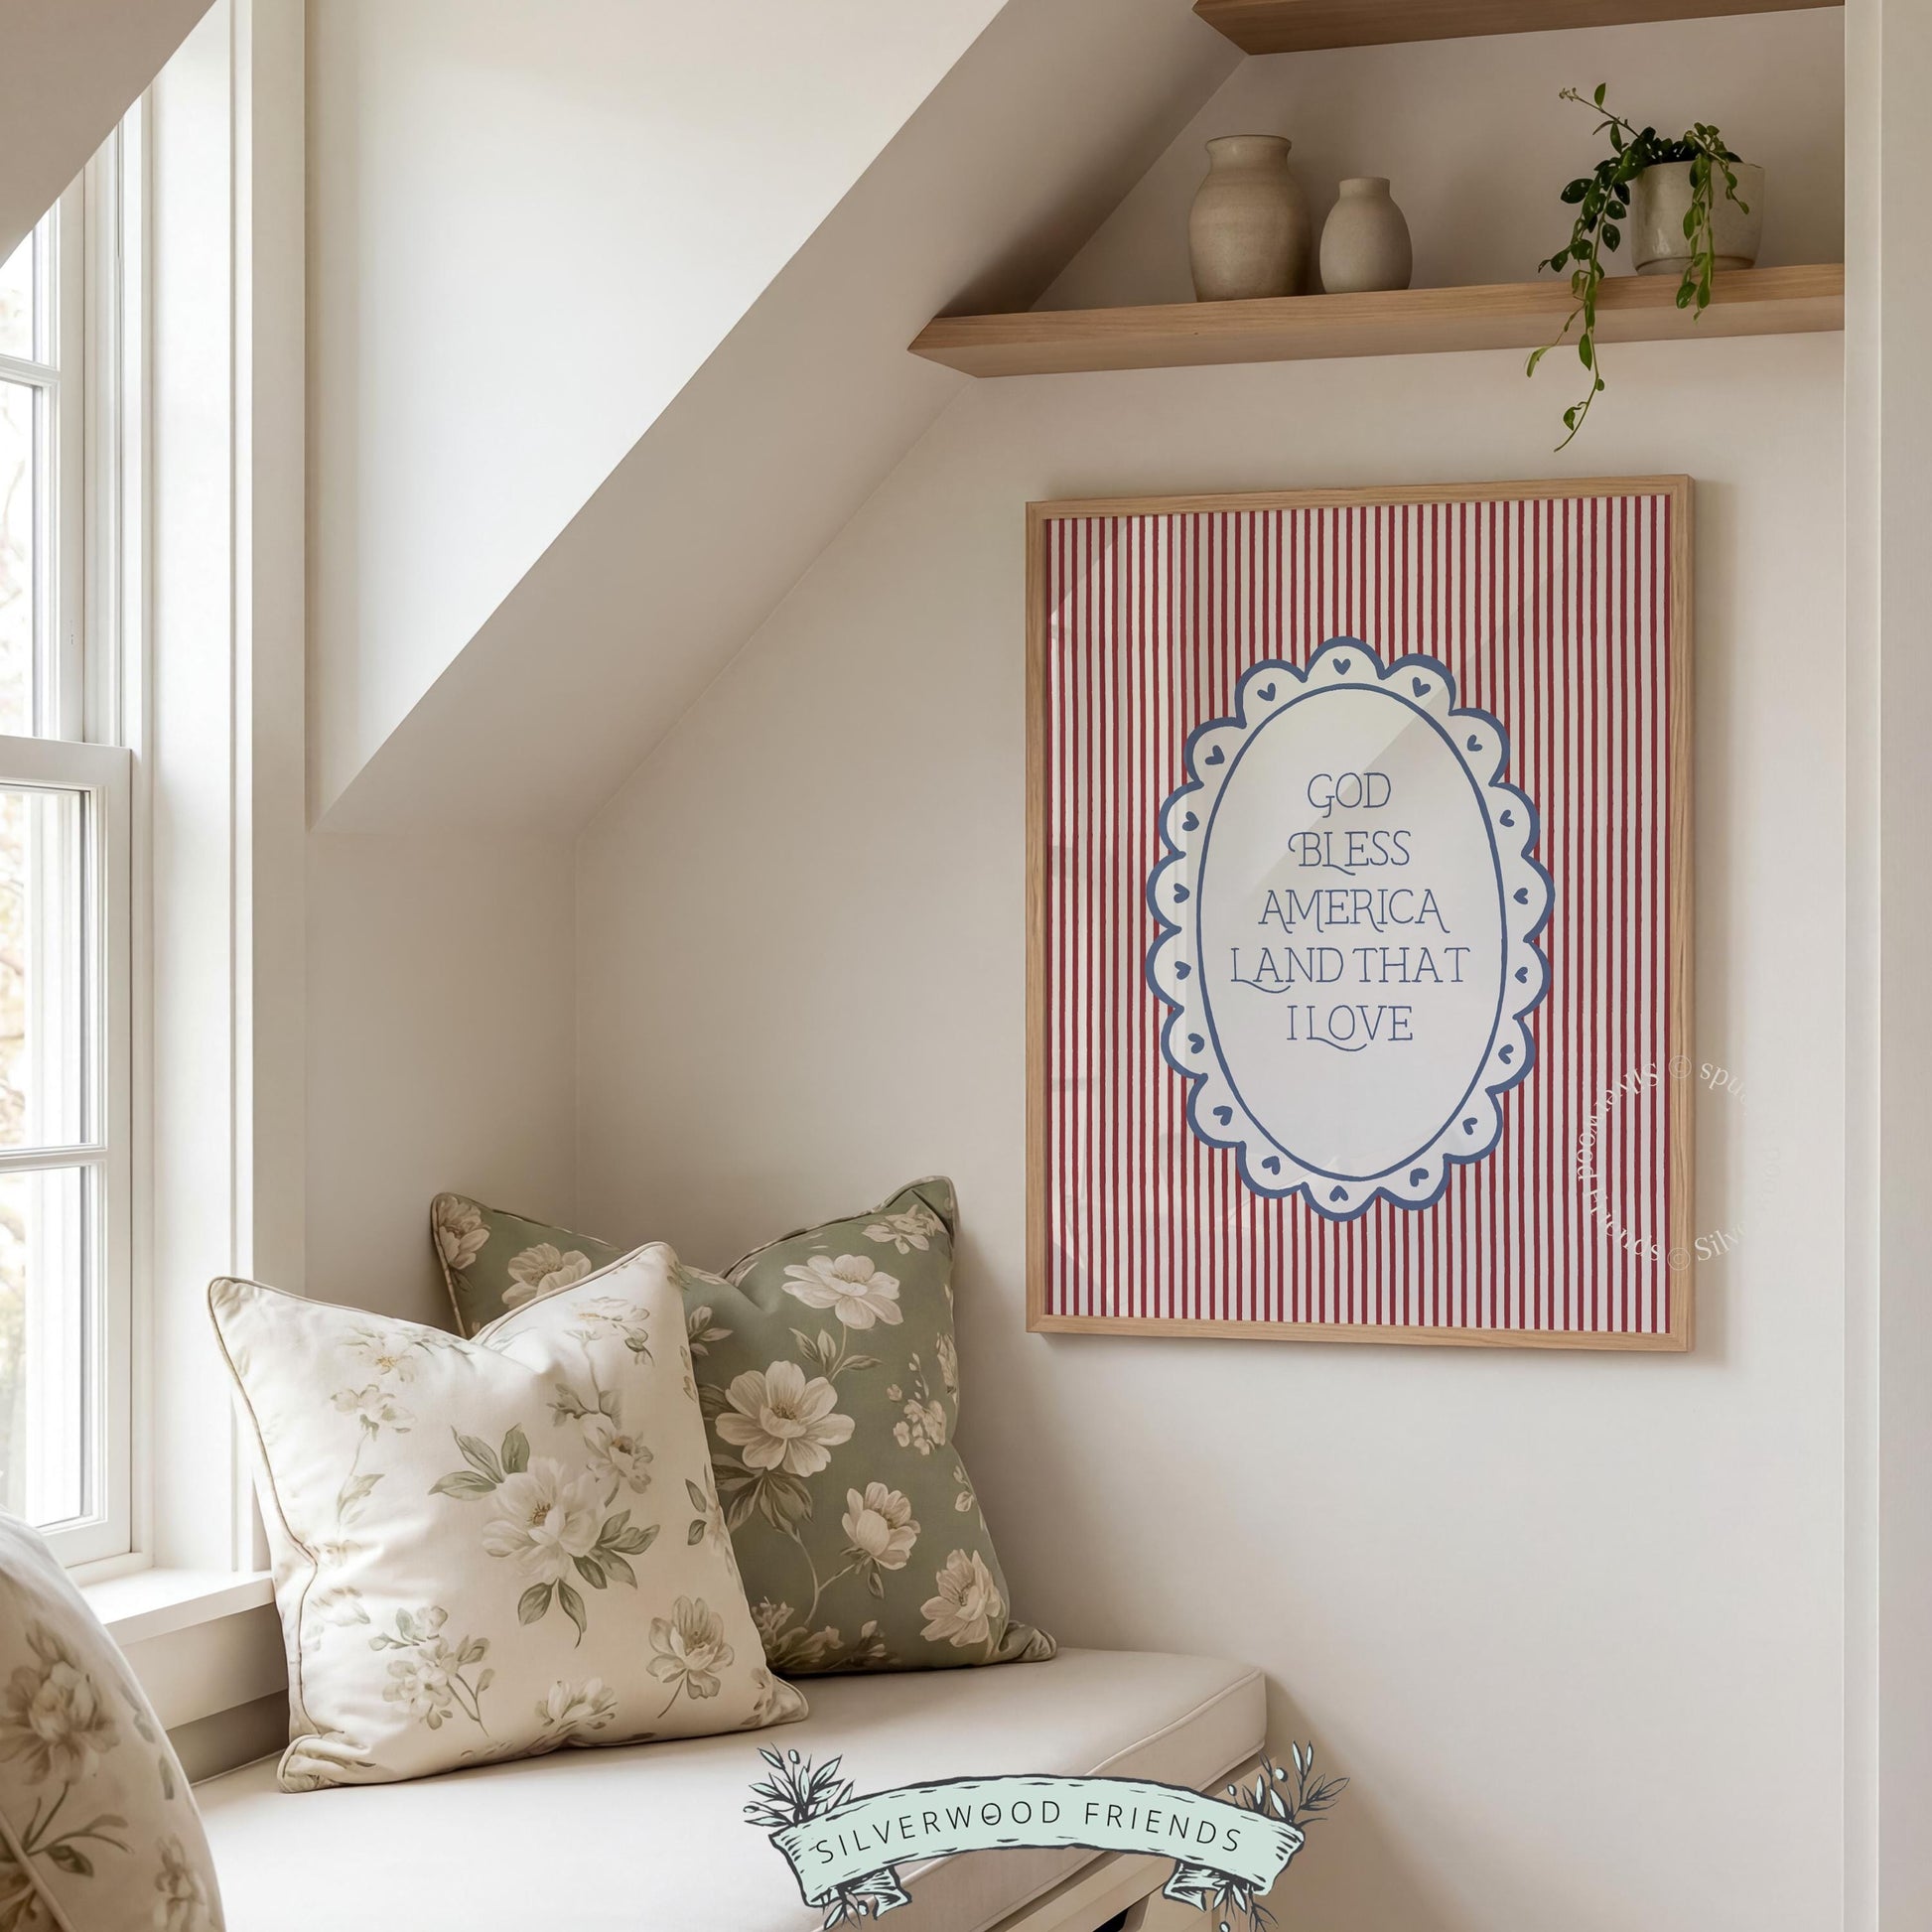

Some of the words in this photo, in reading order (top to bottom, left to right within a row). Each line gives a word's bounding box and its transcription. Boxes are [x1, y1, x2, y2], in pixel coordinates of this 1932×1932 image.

[1308, 771, 1391, 818] GOD
[1288, 830, 1412, 876] BLESS
[1258, 889, 1450, 934] AMERICA
[1230, 947, 1344, 994] LAND
[1352, 947, 1471, 983] THAT
[1287, 1005, 1299, 1040] I
[1307, 1005, 1414, 1052] LOVE
